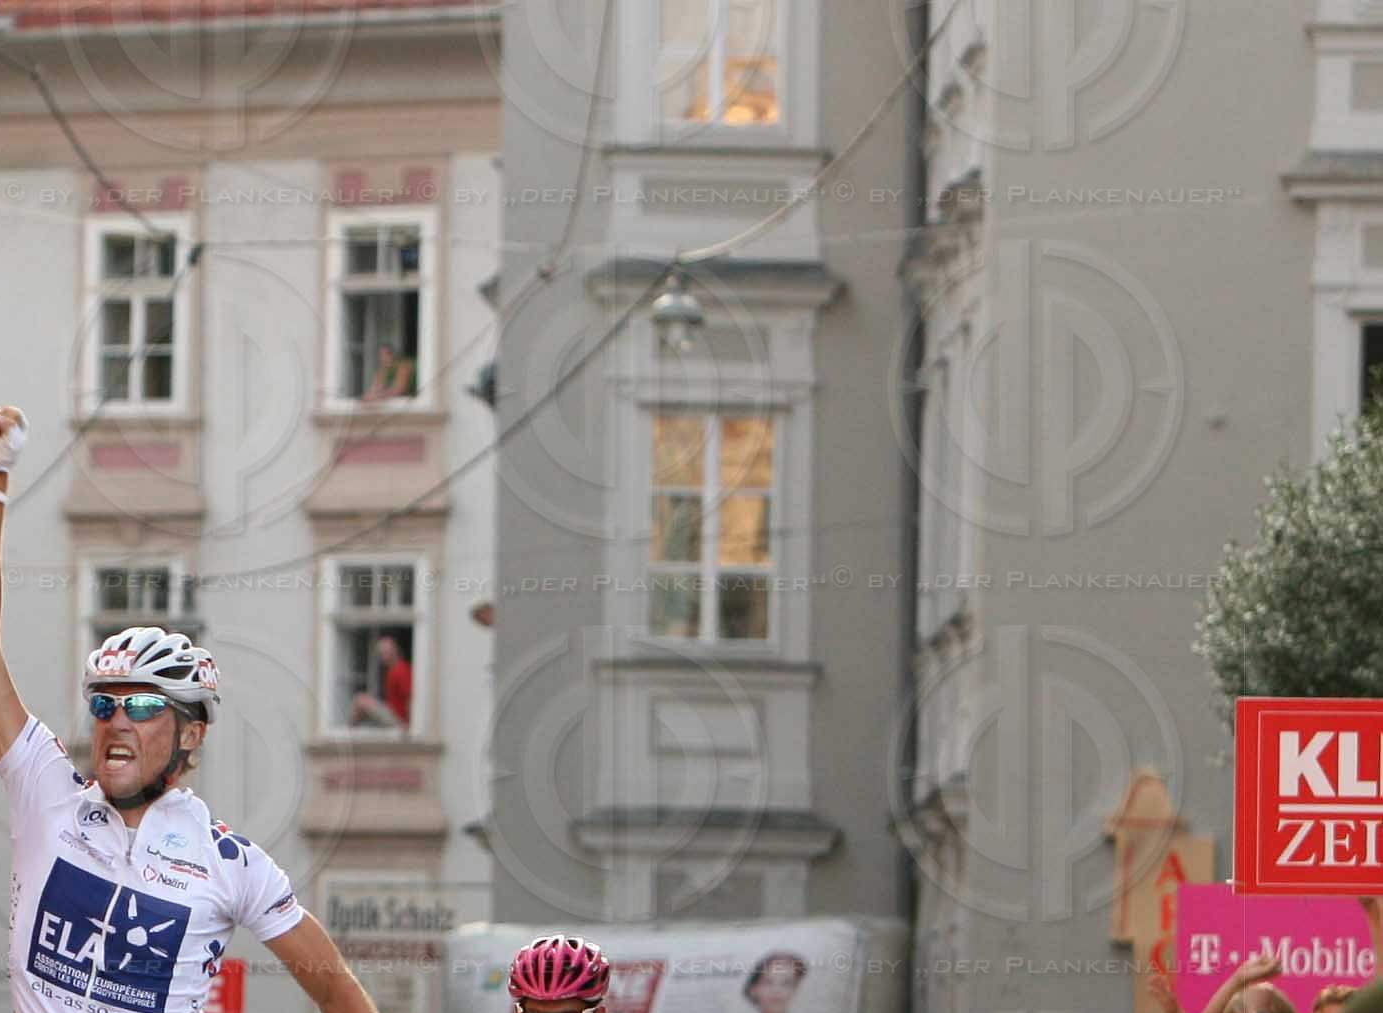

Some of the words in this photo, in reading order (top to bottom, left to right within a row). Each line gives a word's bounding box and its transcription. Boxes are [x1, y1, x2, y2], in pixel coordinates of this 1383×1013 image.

[1278, 731, 1383, 798] KL
[35, 951, 90, 983] ASSOCIATION
[37, 910, 106, 972] ELA
